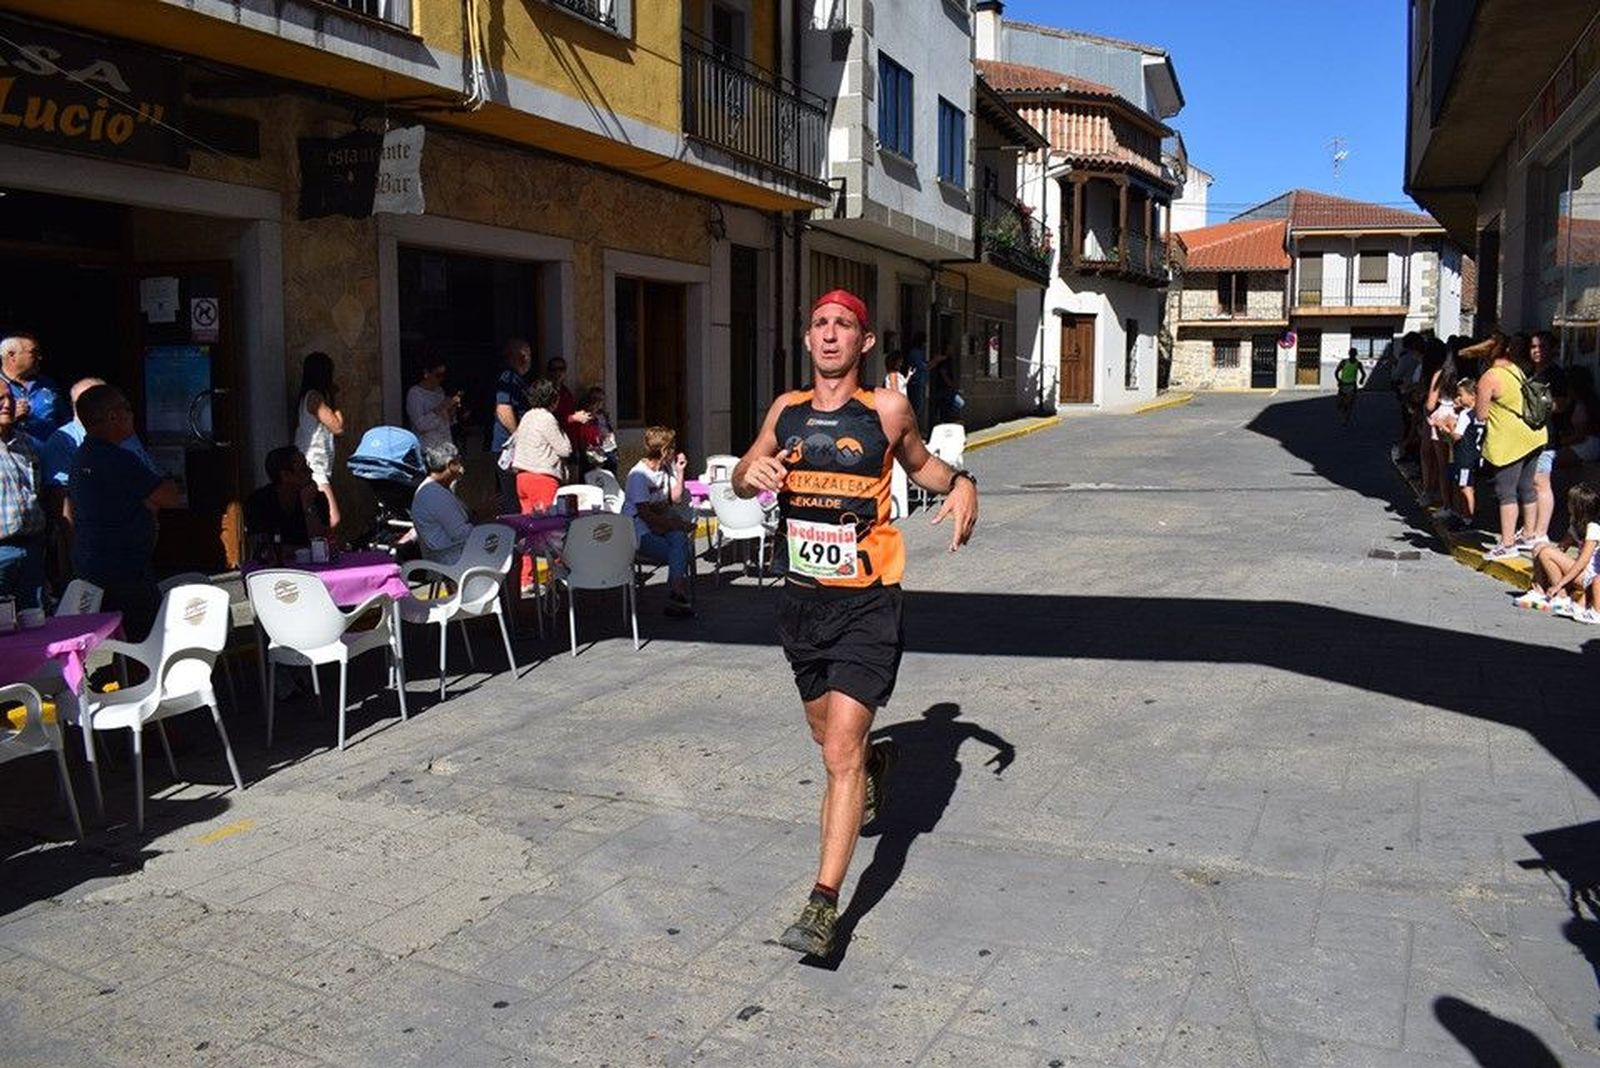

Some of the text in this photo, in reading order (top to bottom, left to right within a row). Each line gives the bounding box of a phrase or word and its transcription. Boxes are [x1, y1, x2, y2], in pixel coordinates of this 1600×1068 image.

[0, 44, 132, 93] SA
[327, 143, 411, 166] estaurante
[377, 172, 411, 194] Bar
[799, 541, 841, 565] 490
